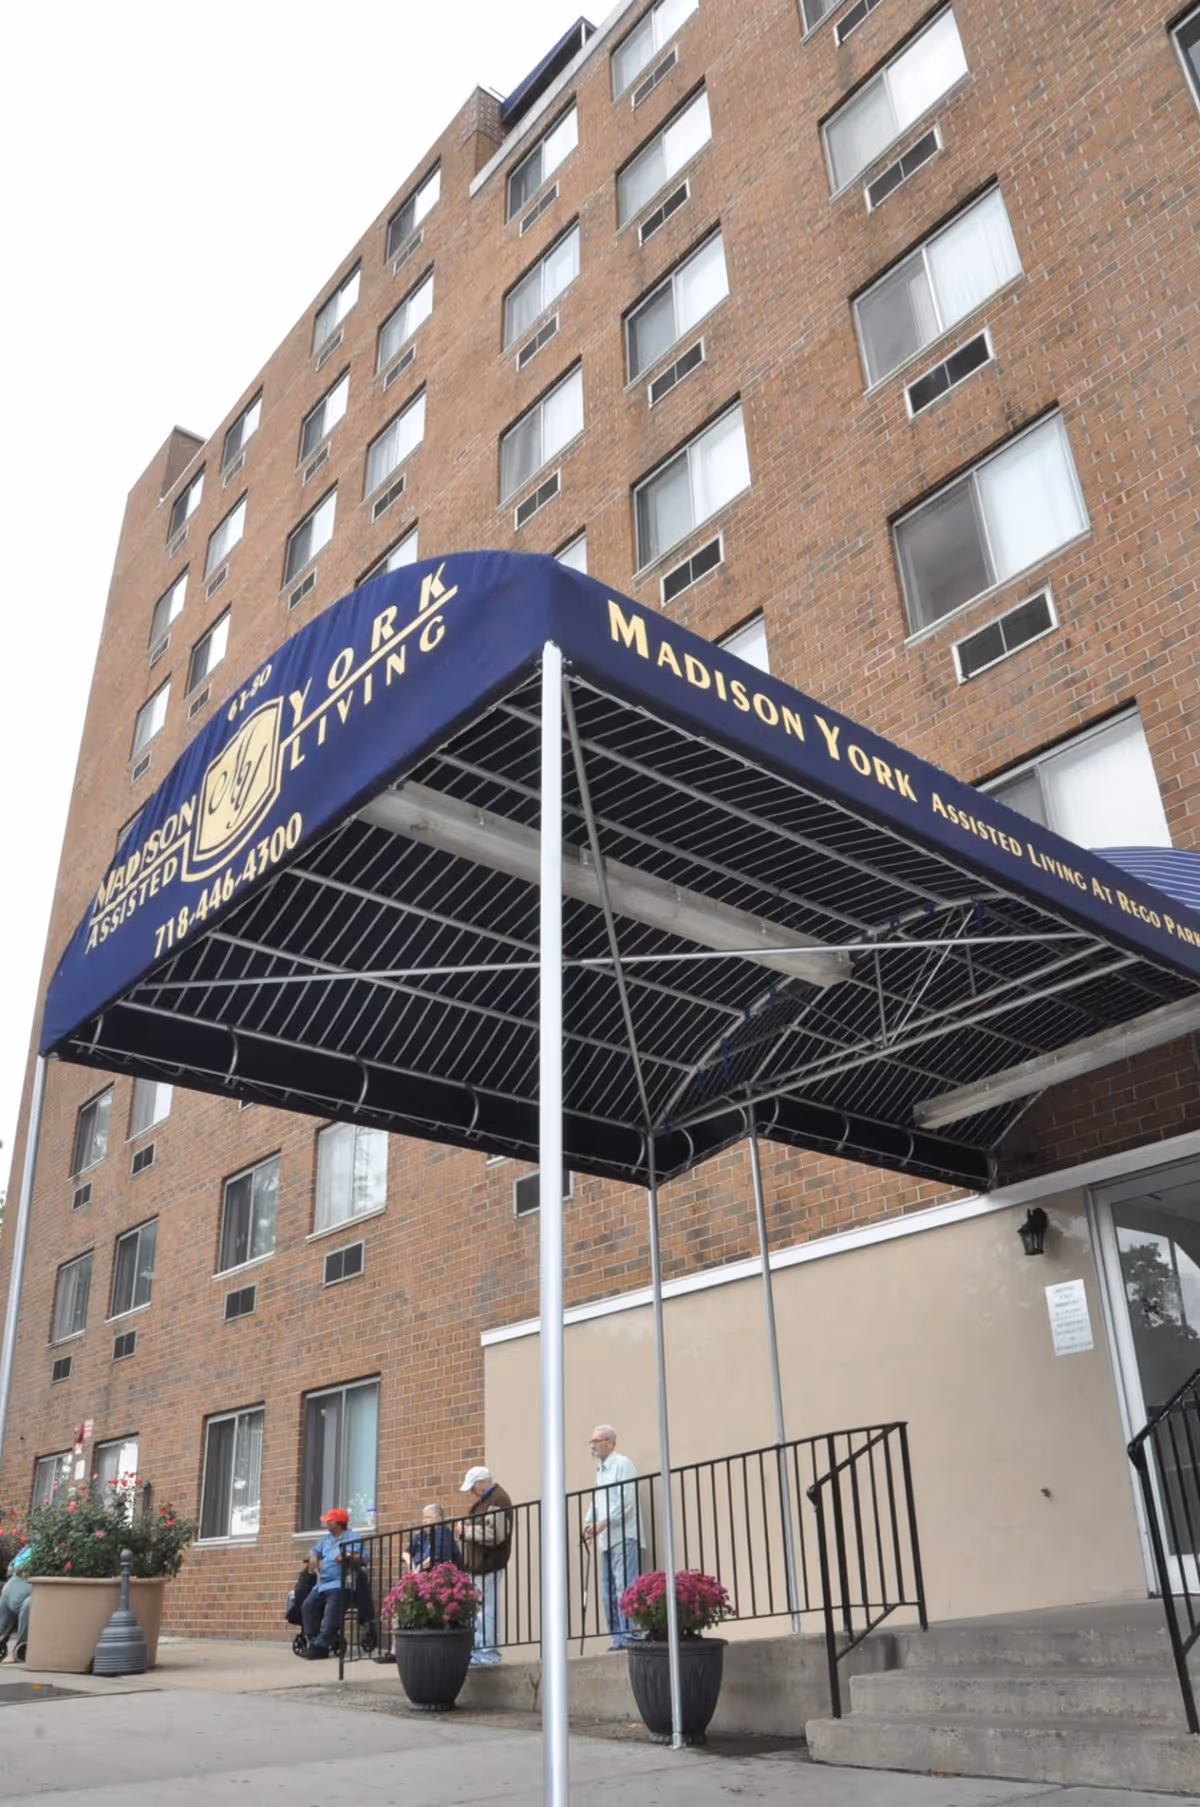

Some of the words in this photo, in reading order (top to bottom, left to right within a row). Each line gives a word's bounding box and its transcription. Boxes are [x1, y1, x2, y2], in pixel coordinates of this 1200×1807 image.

[85, 856, 178, 955] ASSISTED
[289, 615, 446, 770] LIVING
[92, 794, 197, 913] MADISON
[289, 562, 446, 728] YORK
[154, 812, 303, 959] 718-446-4300
[608, 600, 805, 742] MADISON
[814, 714, 917, 803] YORK
[932, 792, 1023, 857] ASSISTED
[1027, 843, 1088, 891] LIVING
[1091, 877, 1114, 905] AT
[1116, 890, 1161, 929] REGO
